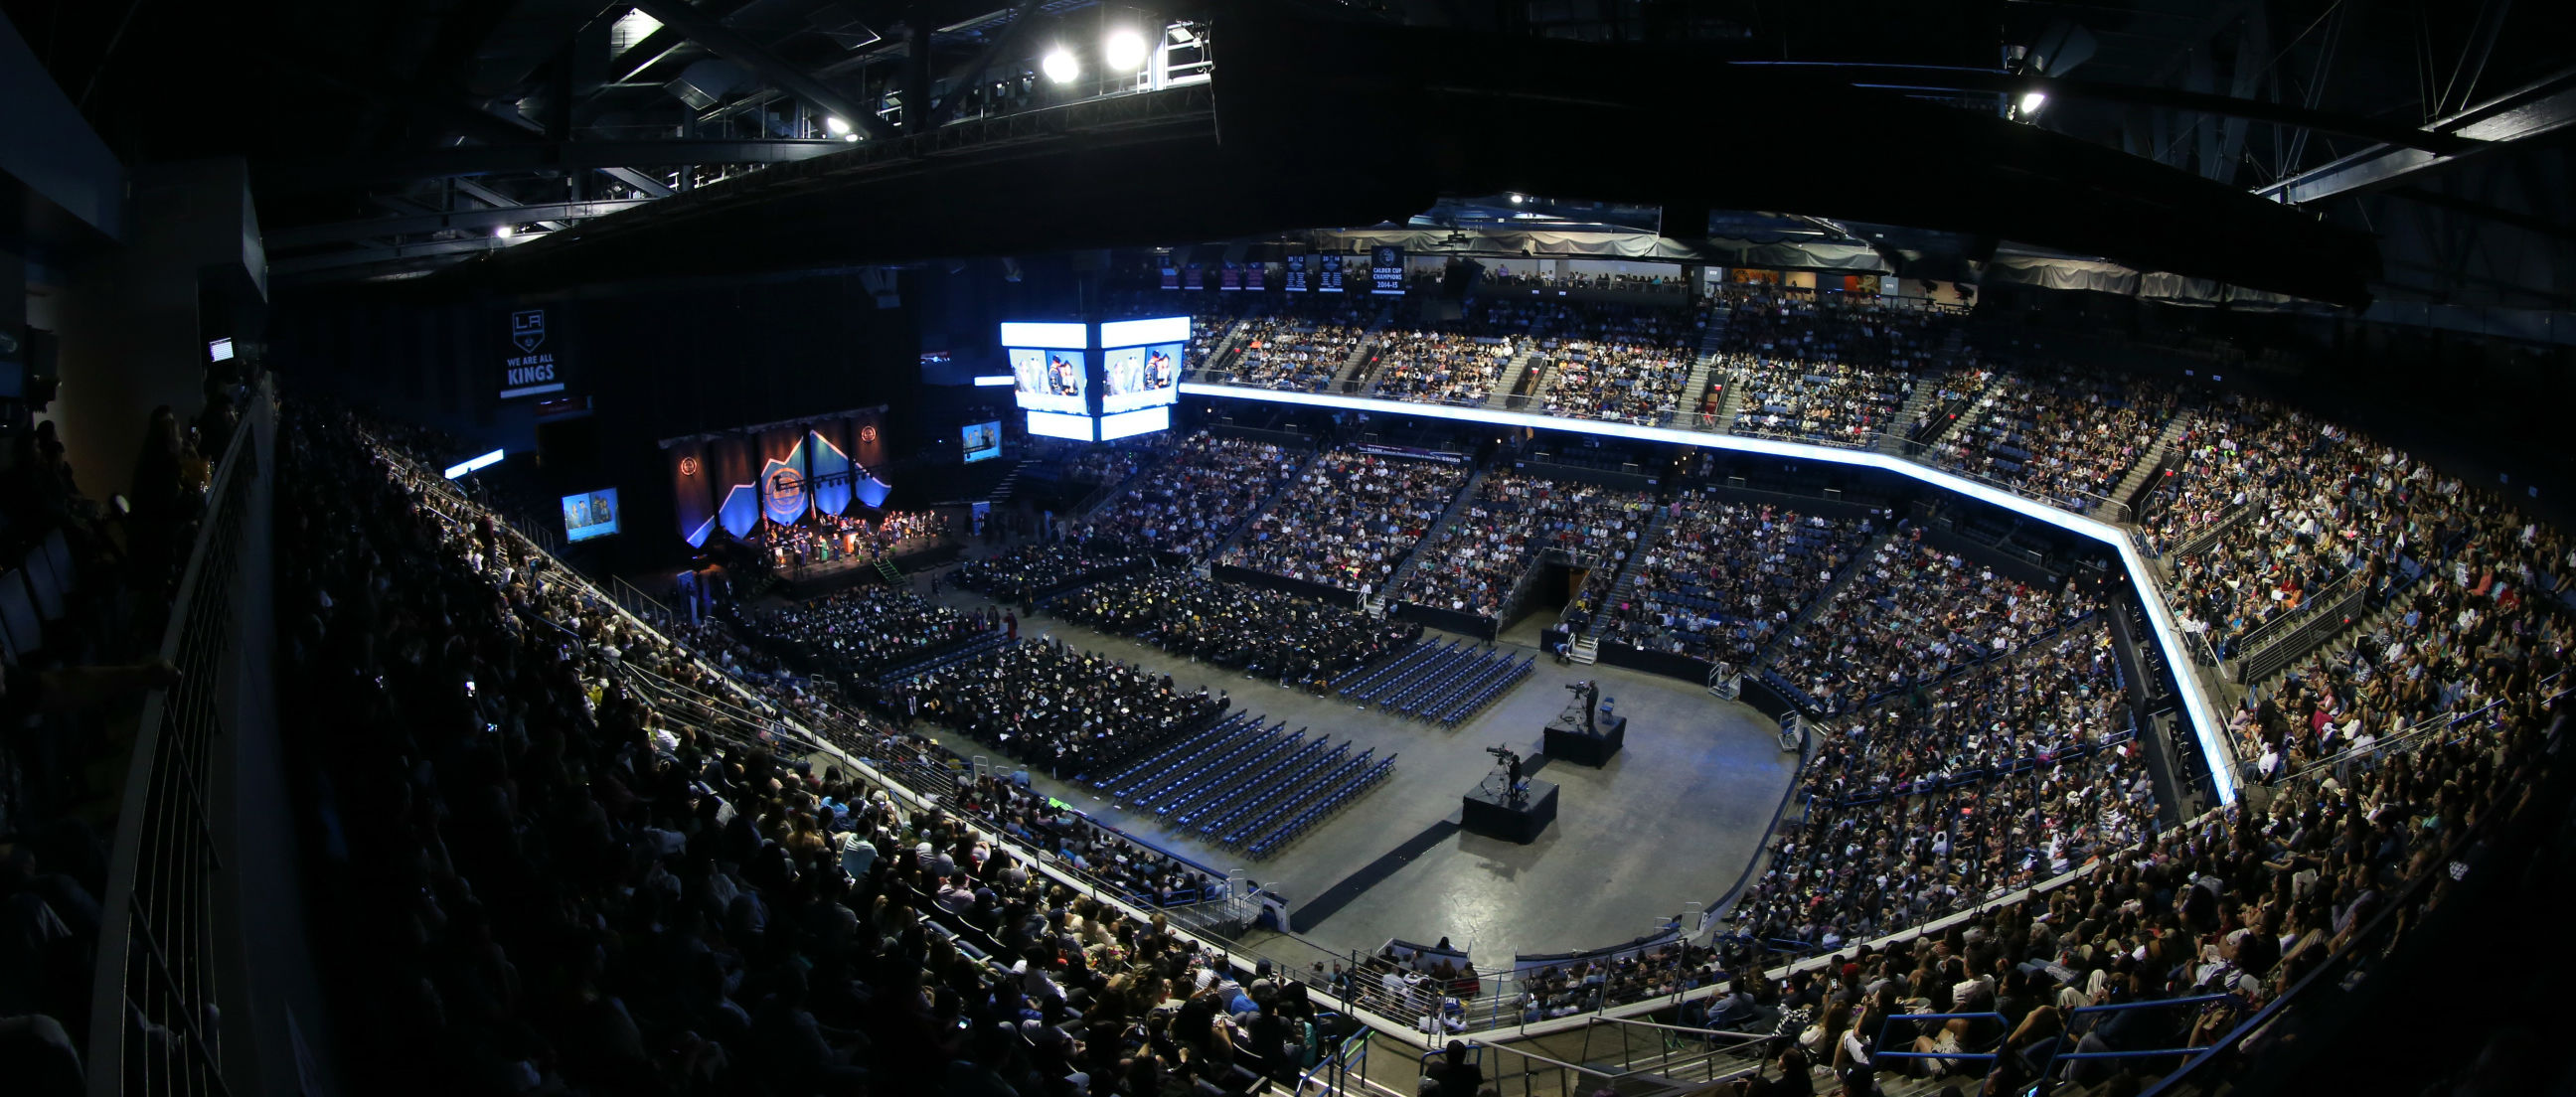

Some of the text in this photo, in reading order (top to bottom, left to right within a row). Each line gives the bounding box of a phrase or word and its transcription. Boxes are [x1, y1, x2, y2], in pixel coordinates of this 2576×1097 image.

[516, 314, 542, 329] LA
[507, 353, 554, 367] WE ARE ALL
[508, 364, 555, 386] KINGS
